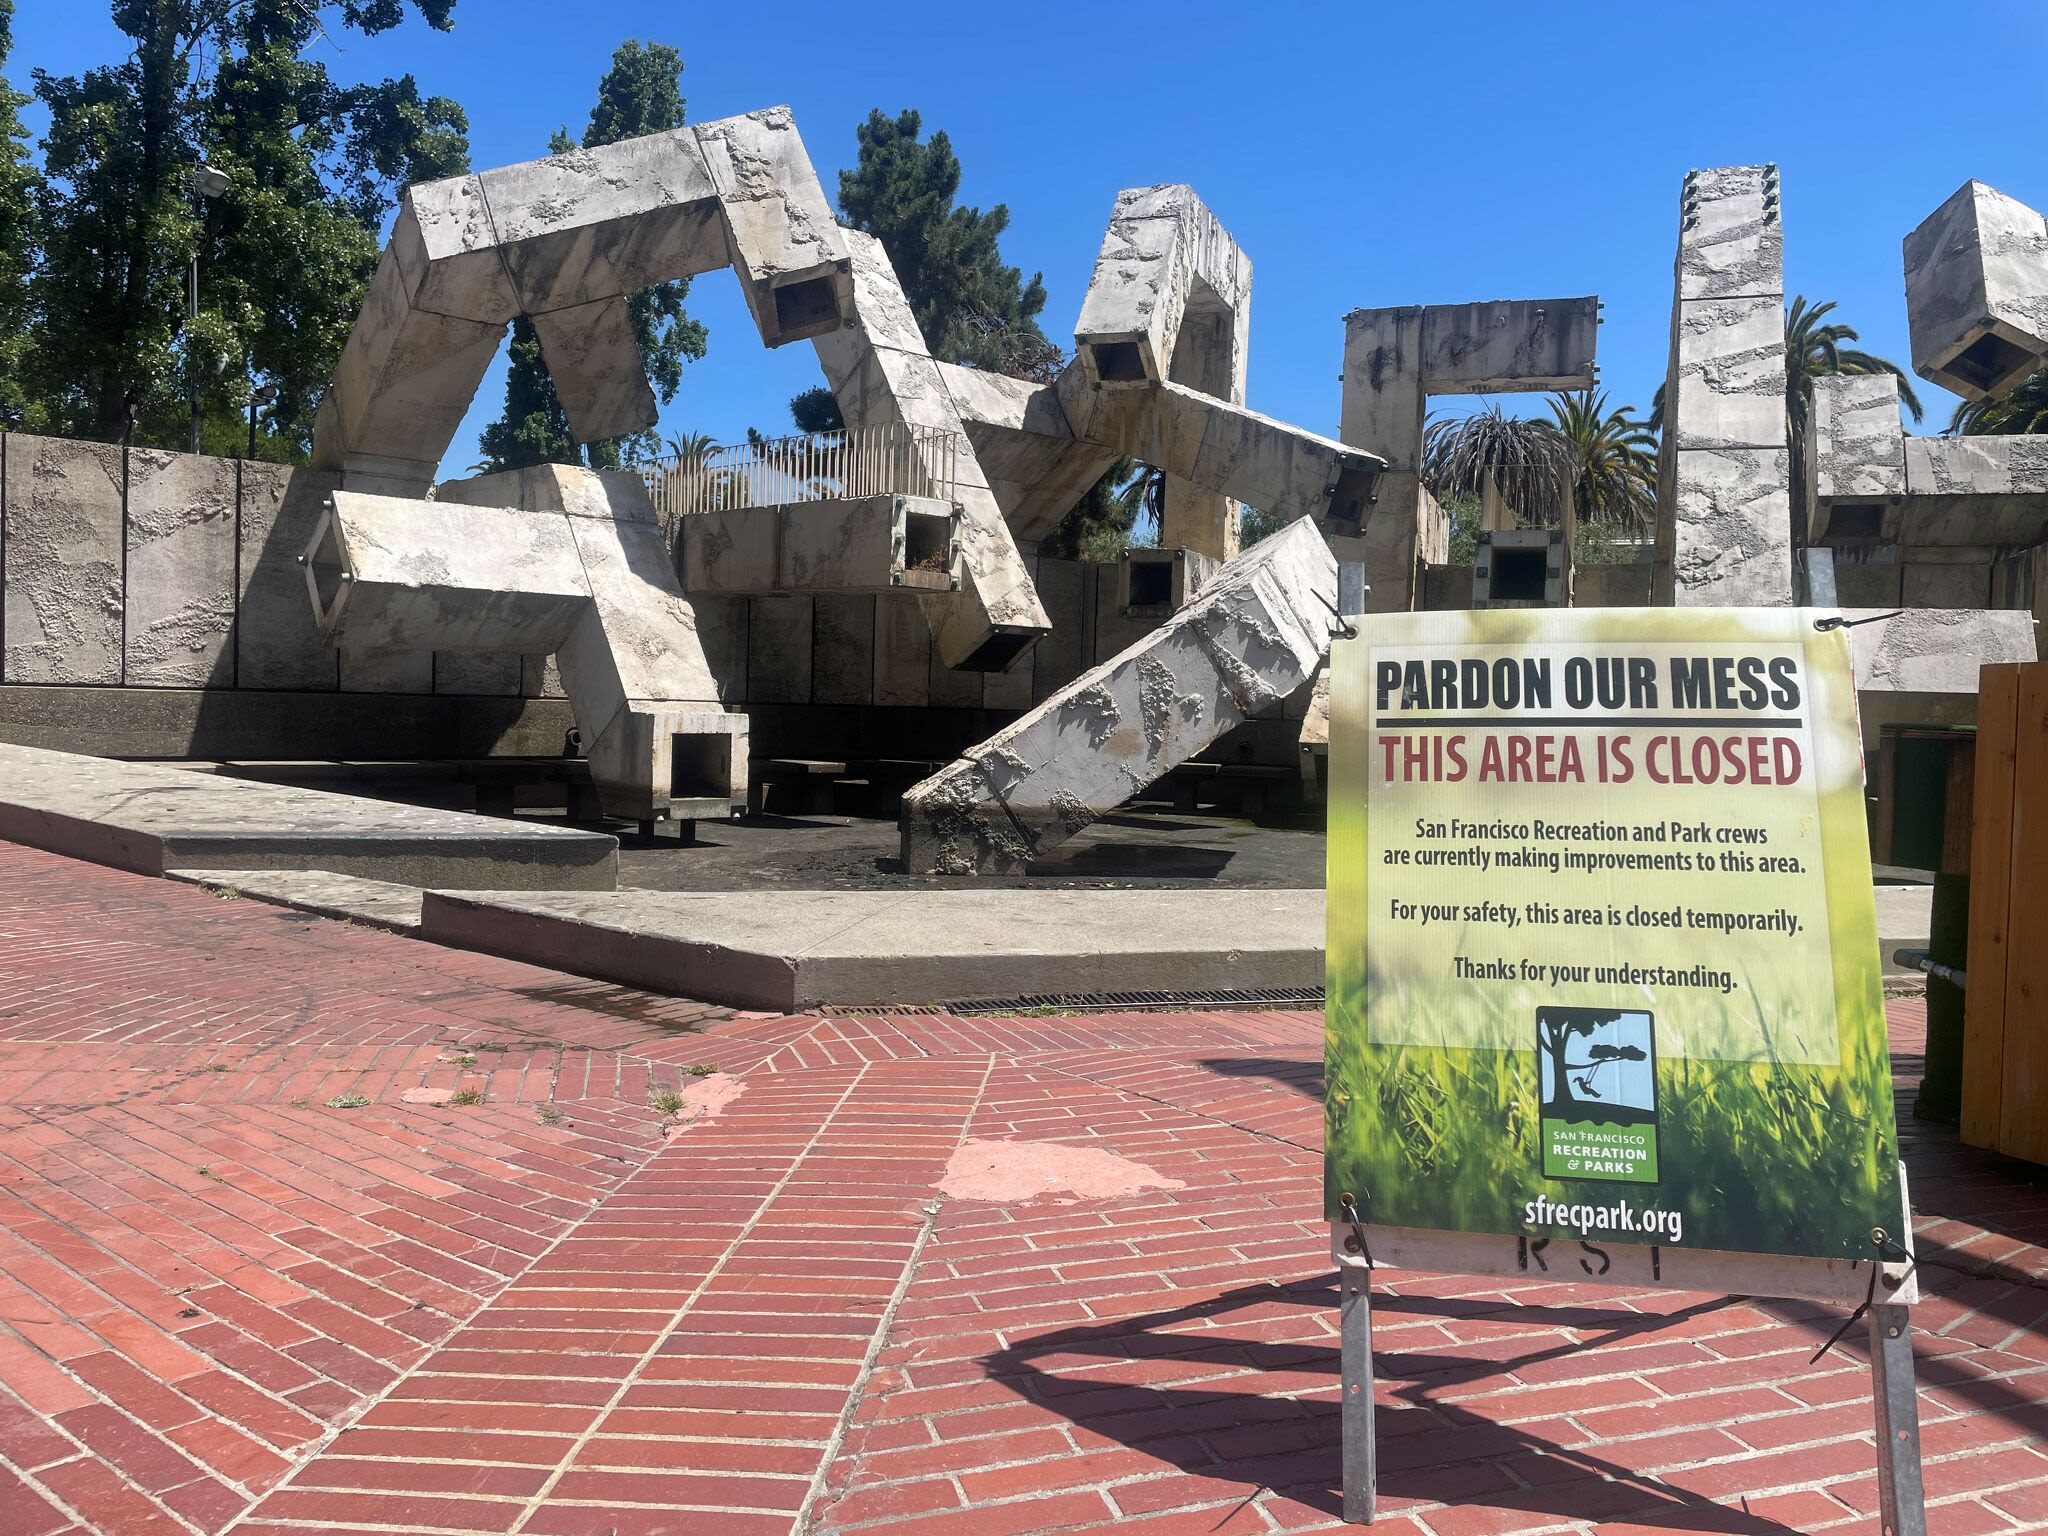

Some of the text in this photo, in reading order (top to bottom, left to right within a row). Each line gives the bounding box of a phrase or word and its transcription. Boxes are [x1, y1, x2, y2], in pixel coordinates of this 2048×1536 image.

[1377, 657, 1800, 710] PARDON OUR MESS
[1379, 736, 1801, 785] THIS AREA IS CLOSED
[1416, 818, 1767, 843] San Francisco Recreation and Park crews
[1384, 846, 1805, 873] are currently making improvements to this area.
[1392, 899, 1802, 936] For your safety, this area is closed temporarily.
[1454, 957, 1737, 994] Thanks for your understanding.
[1553, 1131, 1645, 1145] SAN FRANCISCO
[1553, 1144, 1647, 1160] RECREATION
[1567, 1159, 1634, 1174] & PARKS
[1525, 1194, 1682, 1242] sfrecpark.org
